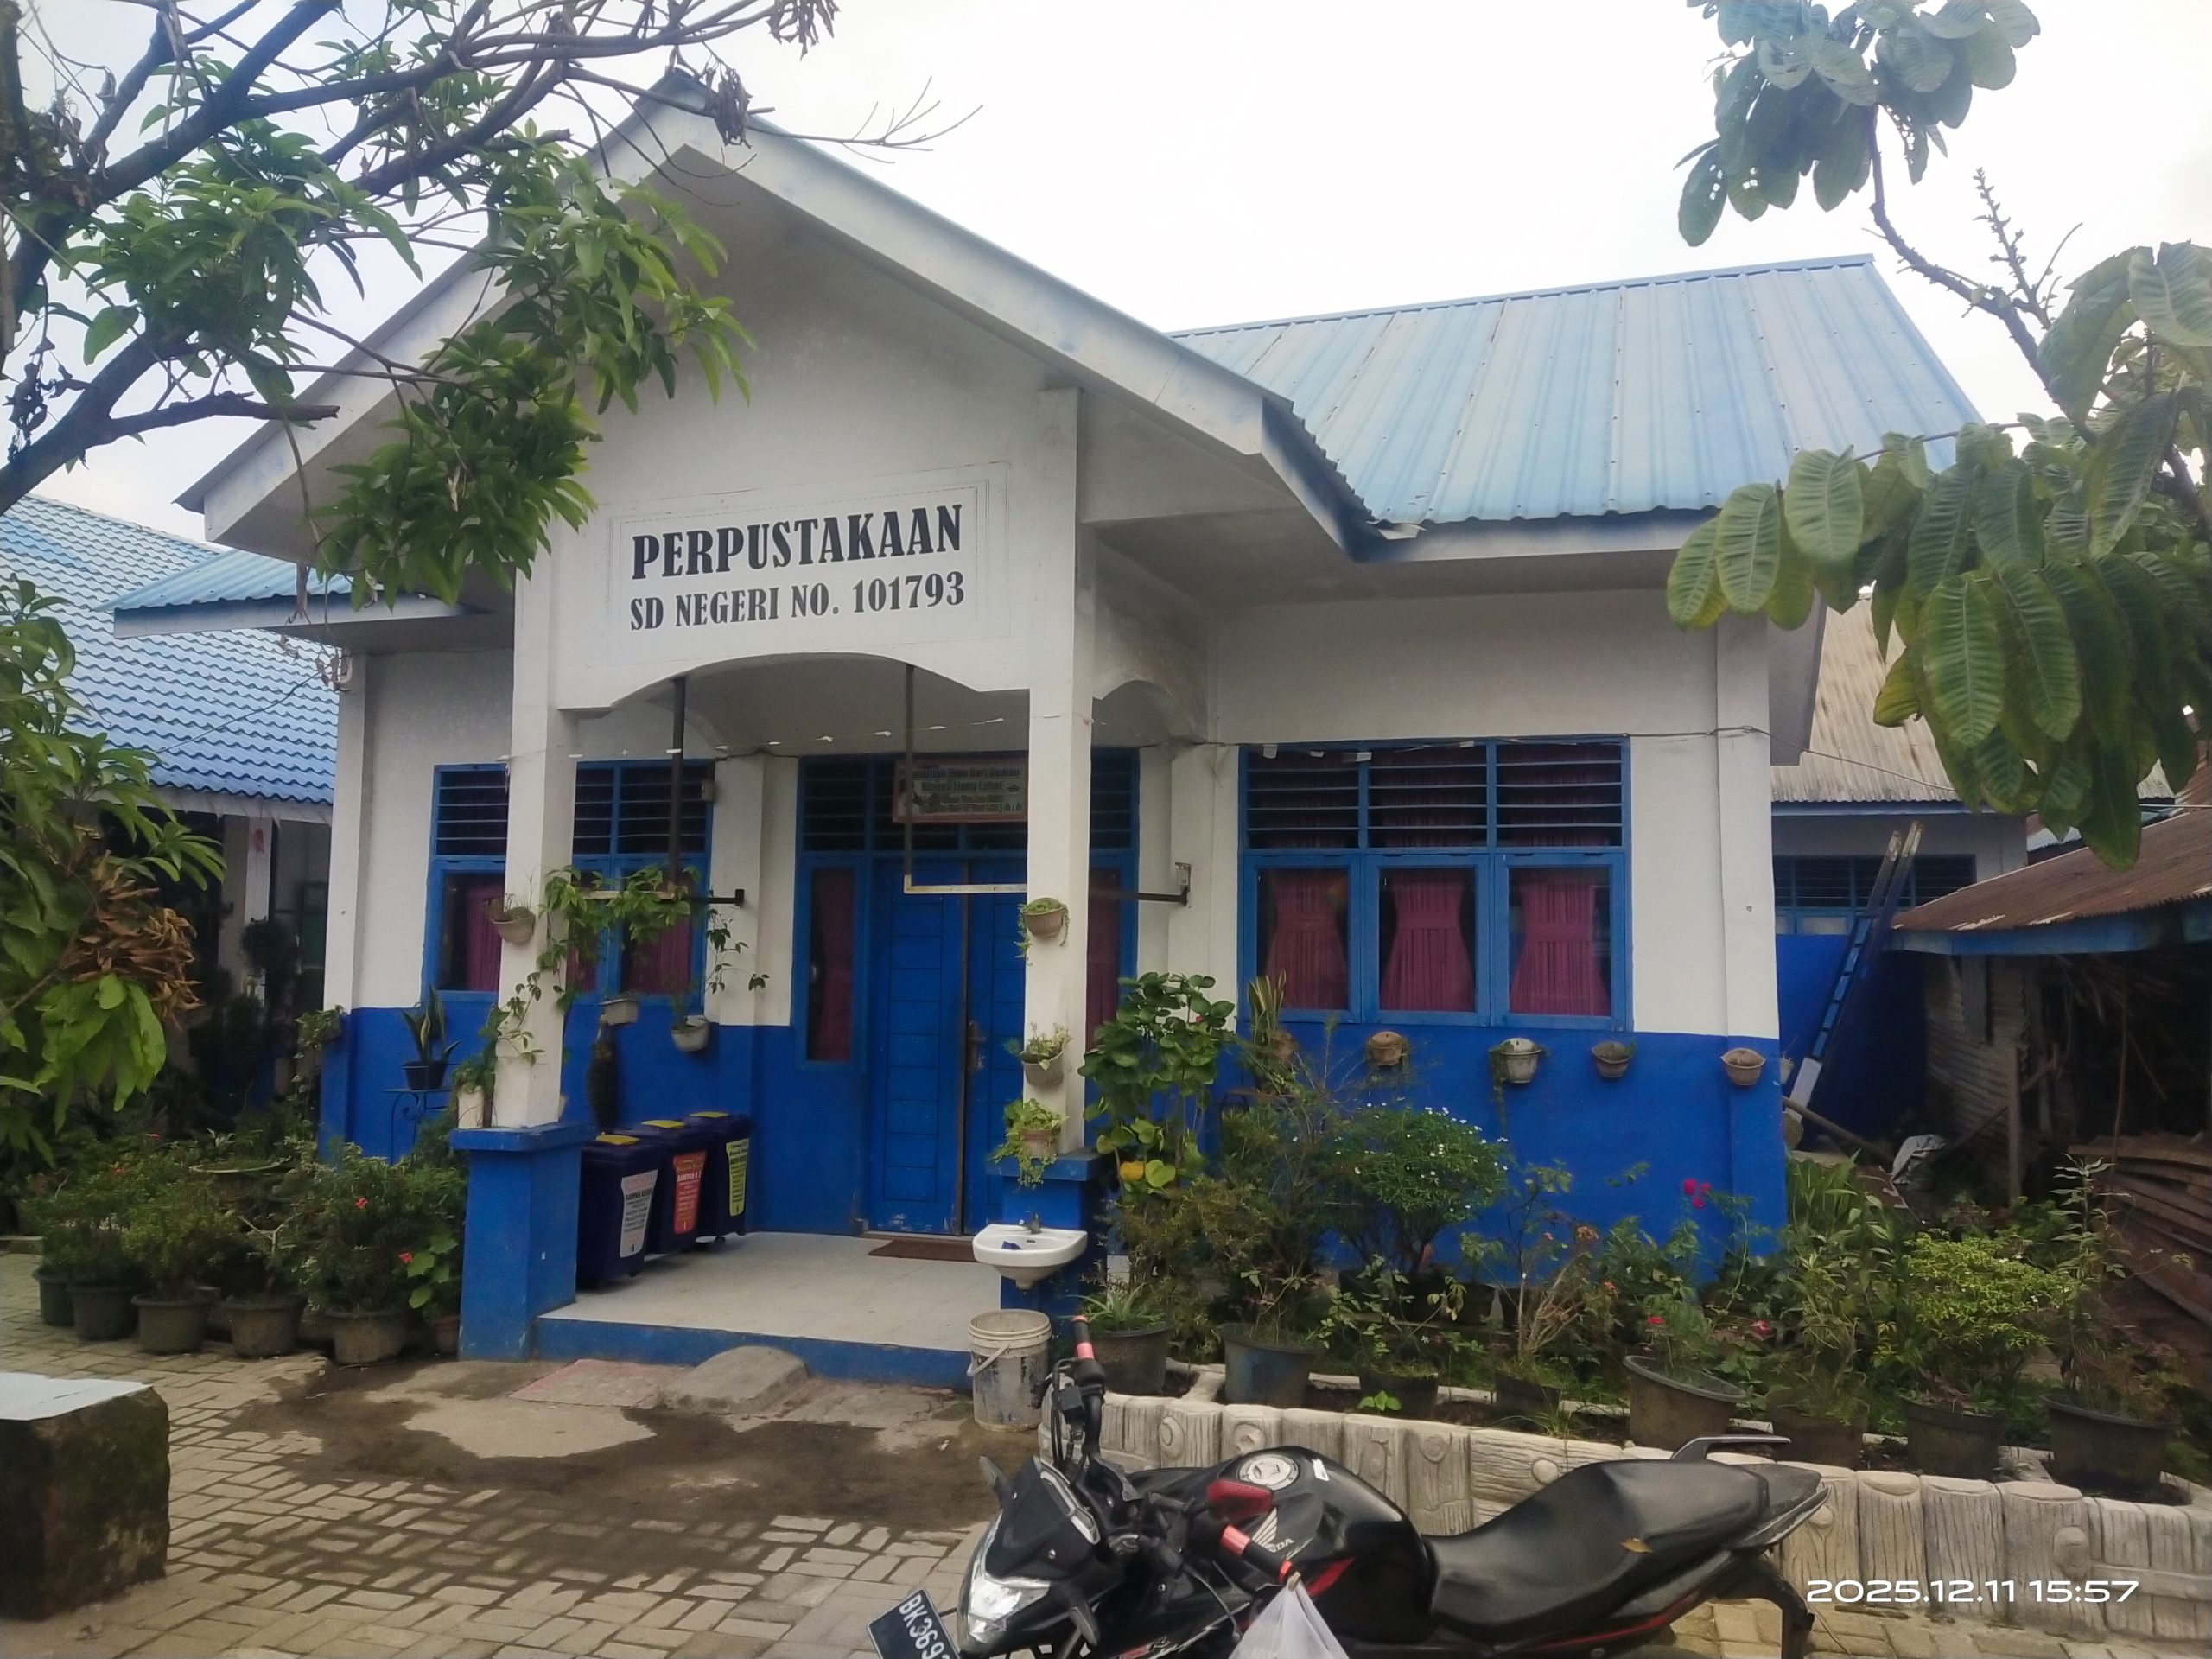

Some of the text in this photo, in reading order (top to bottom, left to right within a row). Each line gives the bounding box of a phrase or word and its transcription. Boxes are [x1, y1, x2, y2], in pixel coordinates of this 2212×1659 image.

[632, 504, 963, 581] PERPUSTAKAAN
[630, 570, 965, 631] SD NEGERI NO. 101793
